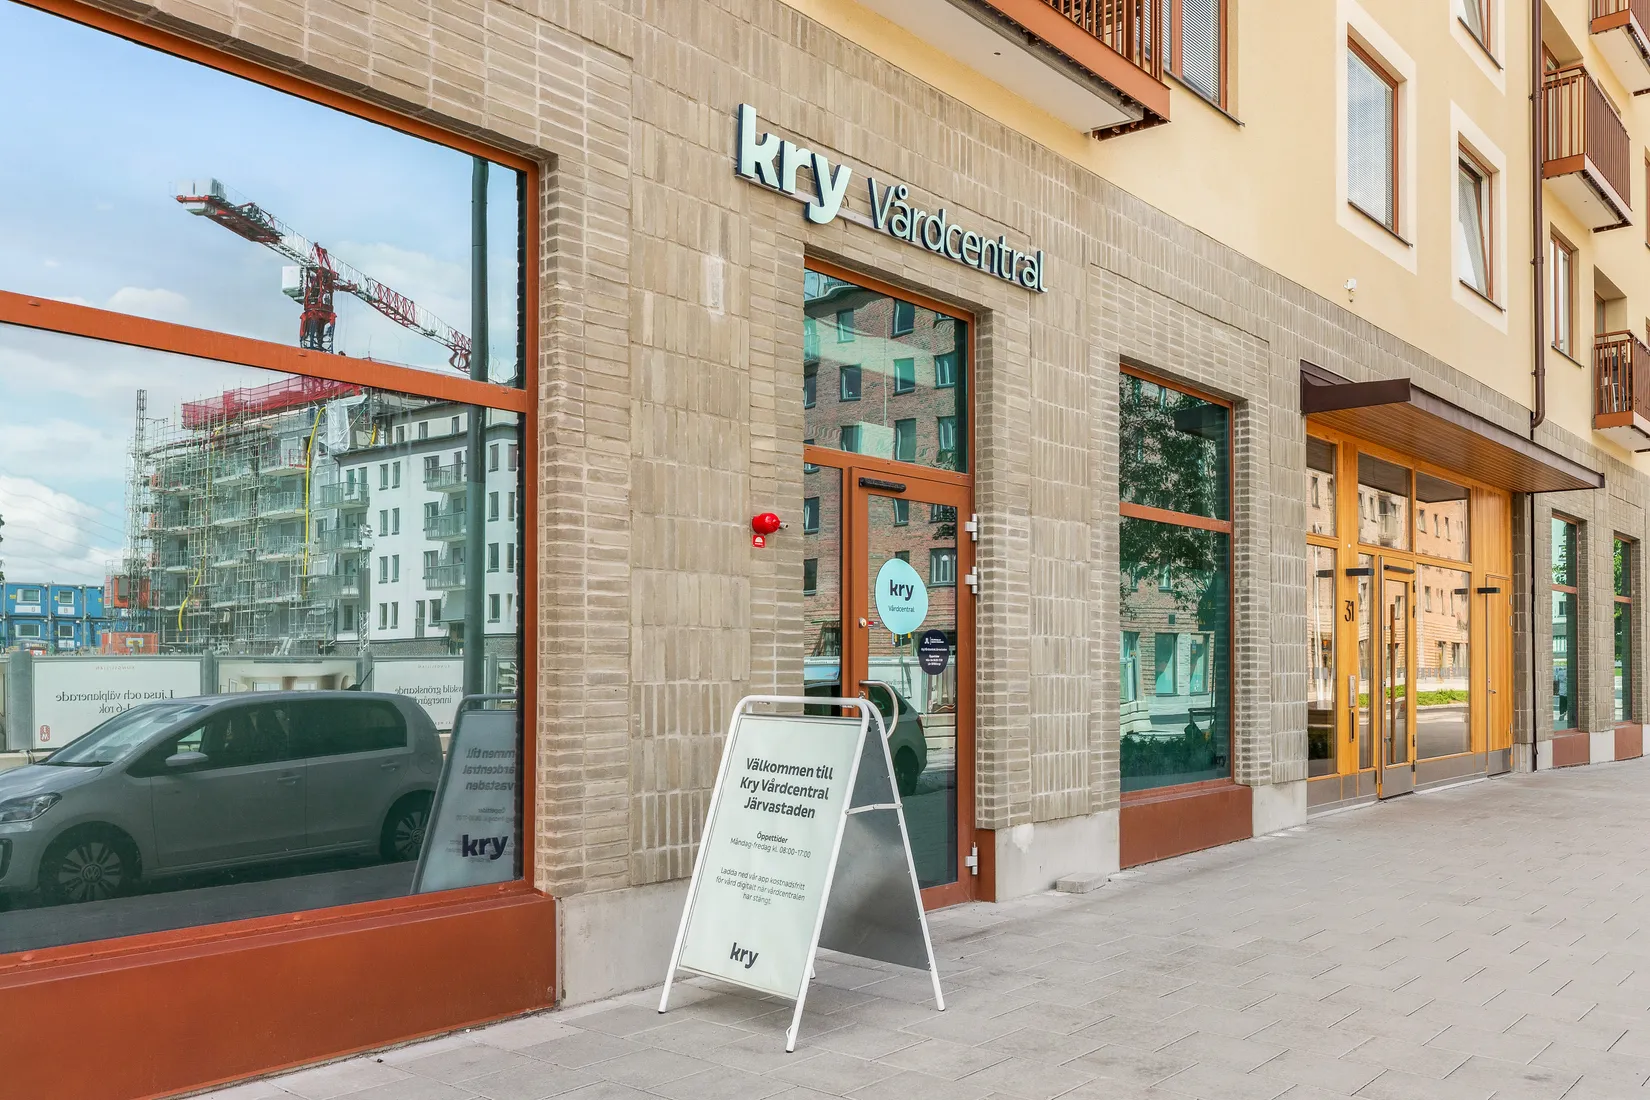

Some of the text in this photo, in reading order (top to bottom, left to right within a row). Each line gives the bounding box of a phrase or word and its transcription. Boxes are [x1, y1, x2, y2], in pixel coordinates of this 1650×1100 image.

[736, 103, 852, 225] kry
[867, 177, 1048, 294] Vårdcentral
[889, 579, 914, 601] kry
[888, 604, 915, 613] Vårdcentral
[1344, 599, 1355, 622] 31
[746, 758, 833, 780] Välkommen till
[740, 776, 829, 800] Kry Vårdcentral
[744, 796, 815, 818] Järvastaden
[462, 834, 508, 860] kry
[756, 831, 788, 844] Öppettider
[779, 846, 811, 858] 08:00-17:00
[715, 875, 724, 884] för
[724, 878, 737, 887] vård
[736, 881, 757, 891] digitalt
[767, 886, 806, 901] vårdcentralen
[720, 866, 805, 891] Ladda ned vår app kostnadsfritt
[742, 892, 753, 901] har
[730, 941, 759, 969] kry
